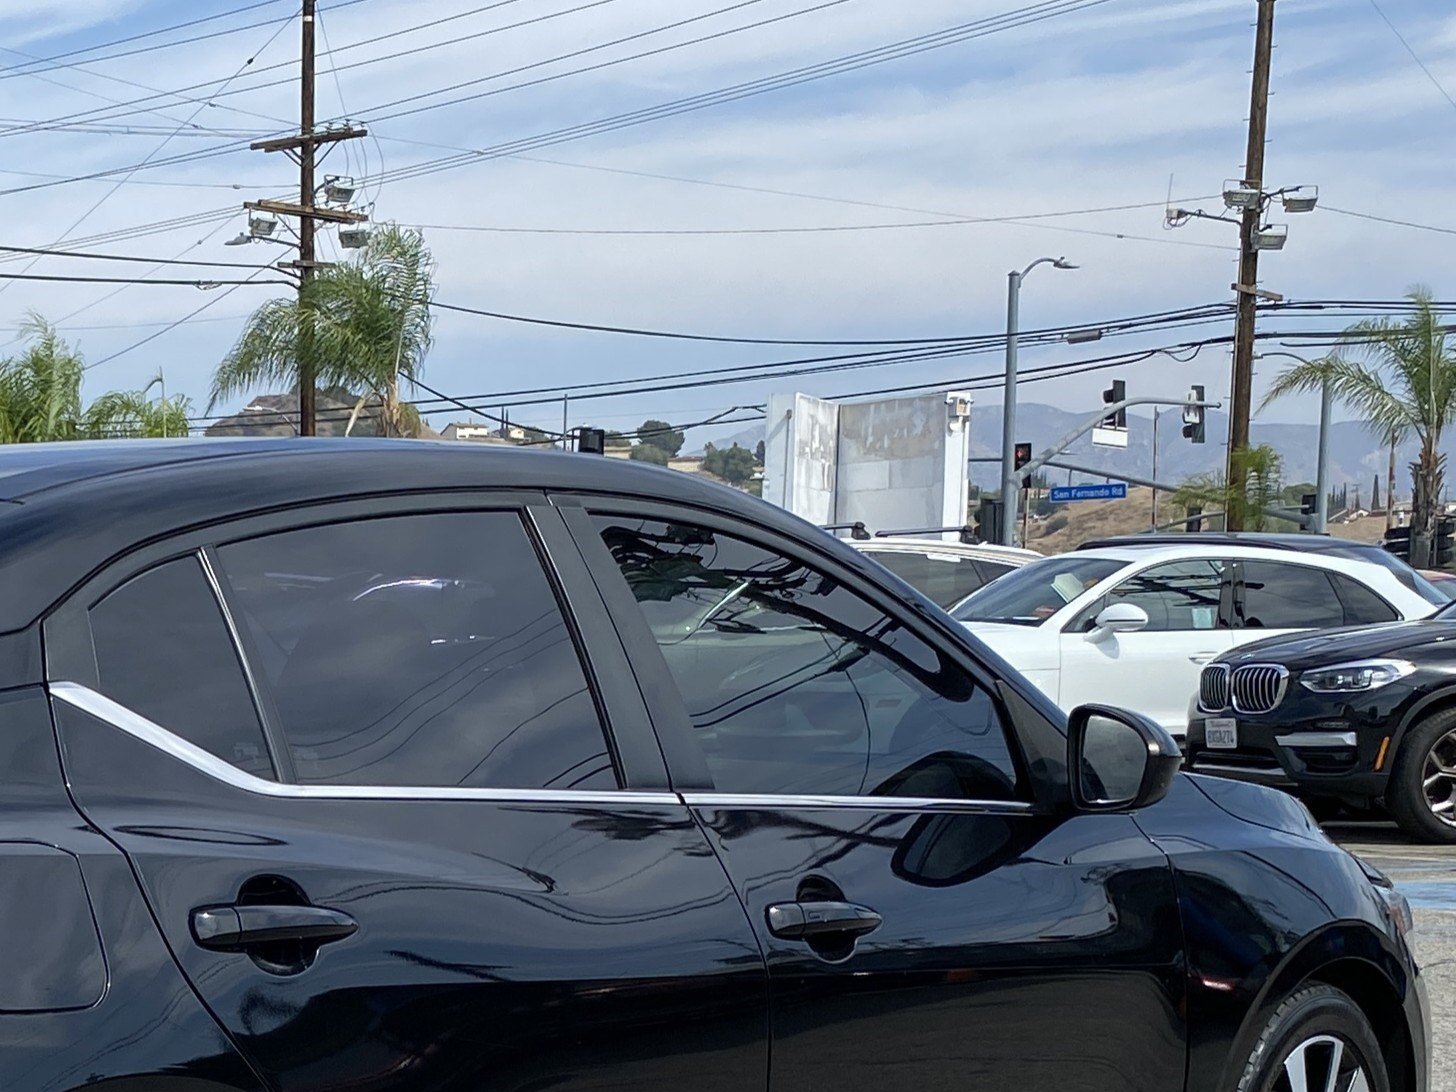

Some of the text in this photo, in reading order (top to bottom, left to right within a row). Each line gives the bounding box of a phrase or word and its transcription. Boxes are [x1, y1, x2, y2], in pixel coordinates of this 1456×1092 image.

[1053, 486, 1124, 499] San Fernando Rd
